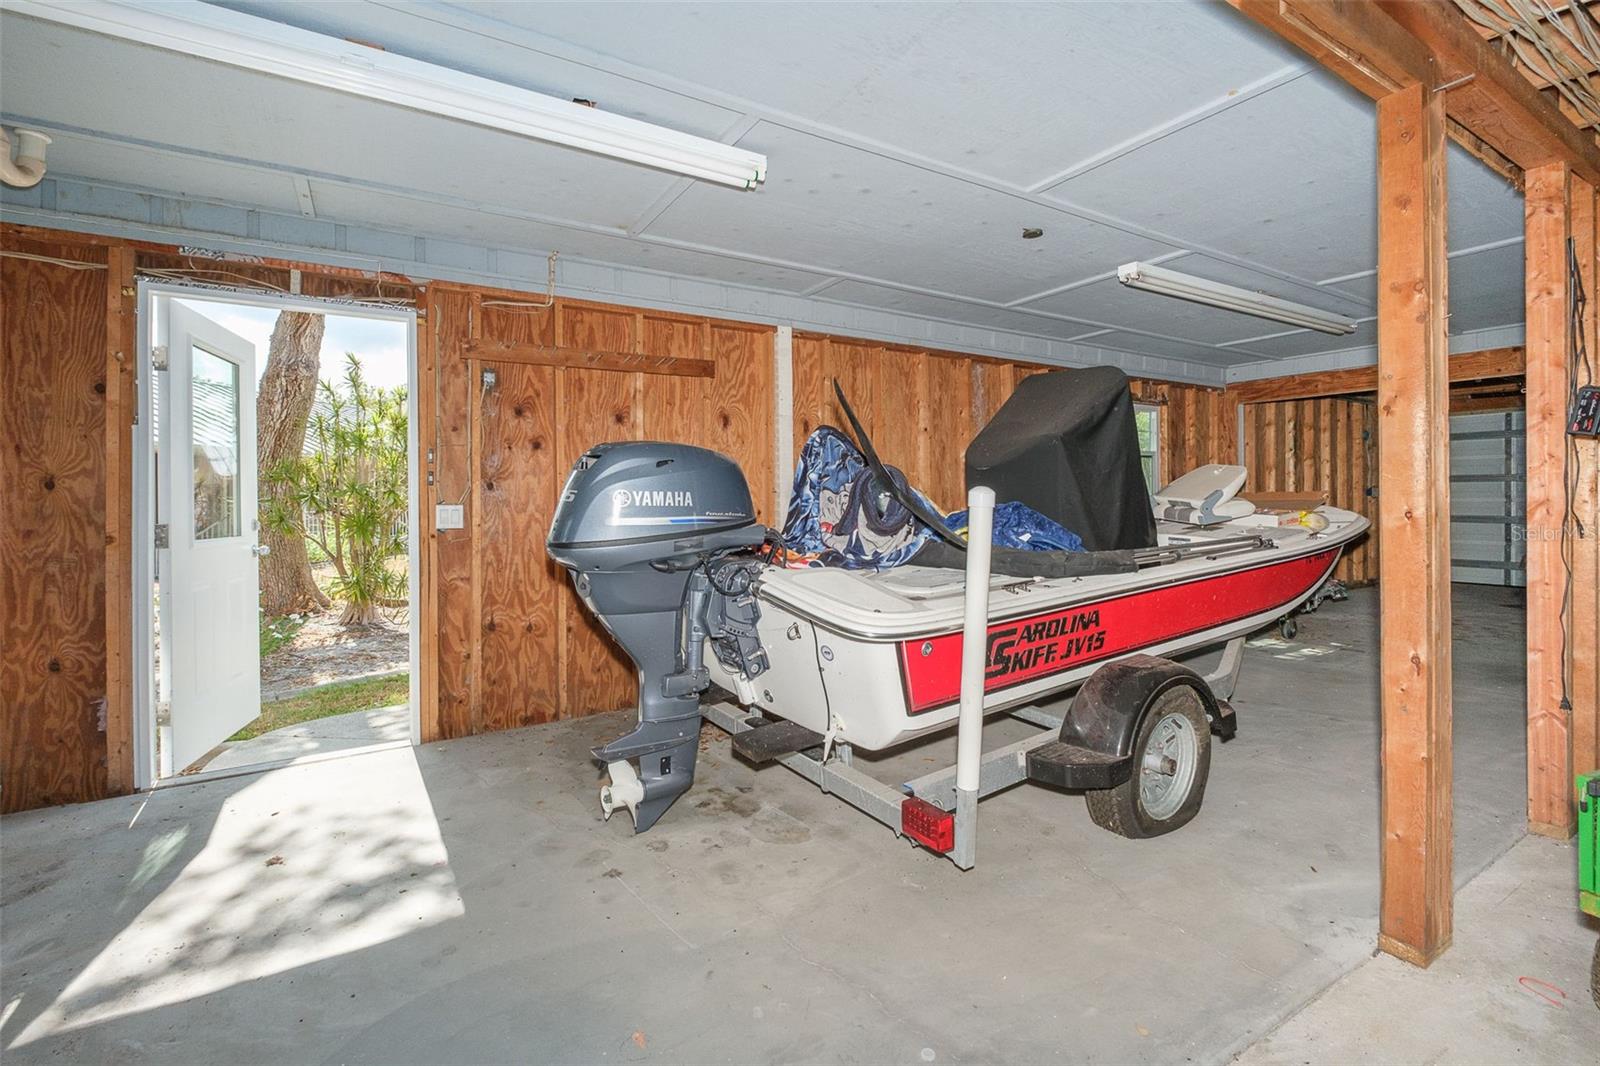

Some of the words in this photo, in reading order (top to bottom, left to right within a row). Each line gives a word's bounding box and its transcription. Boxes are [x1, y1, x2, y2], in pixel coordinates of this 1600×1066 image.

[632, 491, 693, 507] YAMAHA
[986, 609, 1100, 665] CAROLINA
[1060, 630, 1106, 660] JV15
